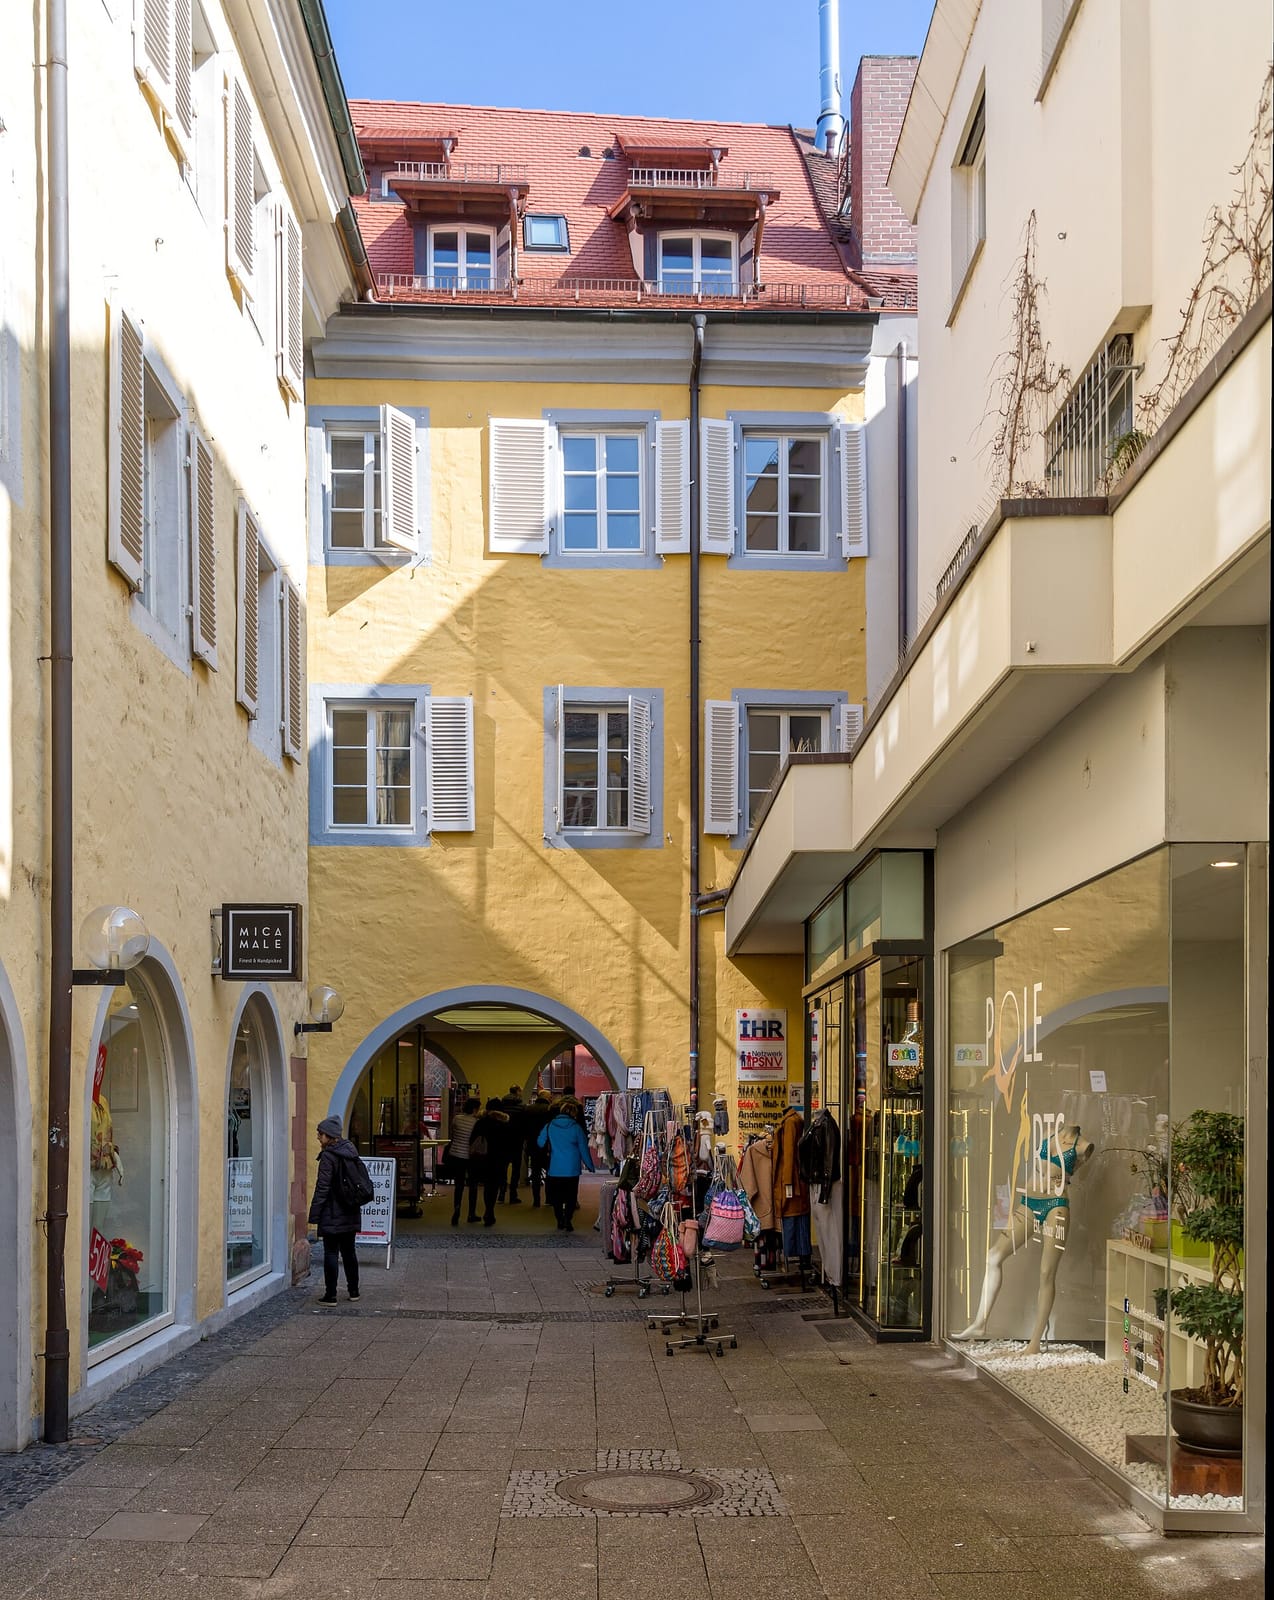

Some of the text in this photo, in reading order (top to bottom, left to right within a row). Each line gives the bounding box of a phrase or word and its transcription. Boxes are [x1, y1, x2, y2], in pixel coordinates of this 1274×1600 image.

[239, 926, 282, 937] MICA
[239, 939, 282, 949] MALE
[985, 982, 1044, 1074] POLE
[891, 1048, 917, 1061] SALE
[752, 1057, 783, 1067] PSNV
[385, 1179, 390, 1189] &
[89, 1233, 109, 1281] -50%
